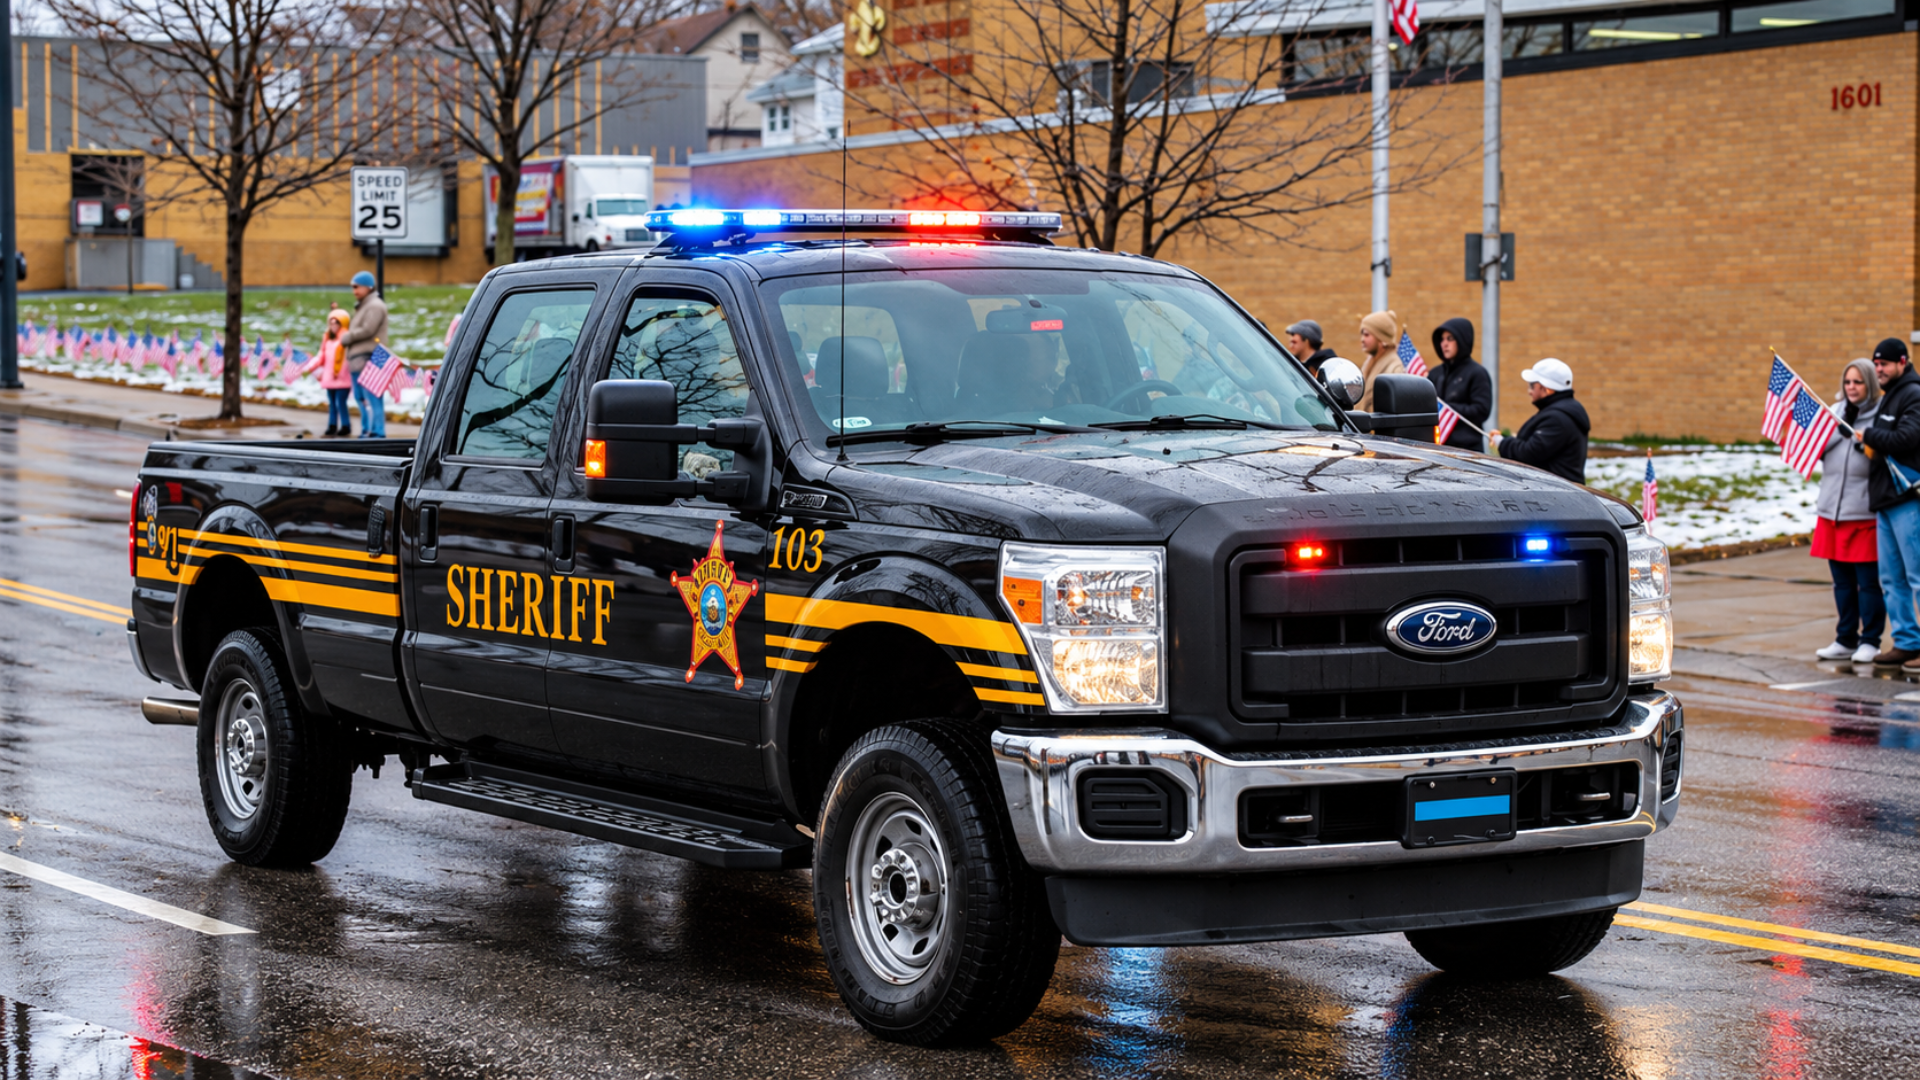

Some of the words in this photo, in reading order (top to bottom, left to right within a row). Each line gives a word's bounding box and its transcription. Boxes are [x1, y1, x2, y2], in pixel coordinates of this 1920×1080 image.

[1832, 82, 1881, 111] 1601
[358, 175, 402, 187] SPEED
[361, 190, 396, 201] LIMIT
[359, 205, 401, 229] 25
[768, 525, 825, 573] 103
[446, 563, 615, 646] SHERIFF
[1417, 612, 1476, 642] Ford
